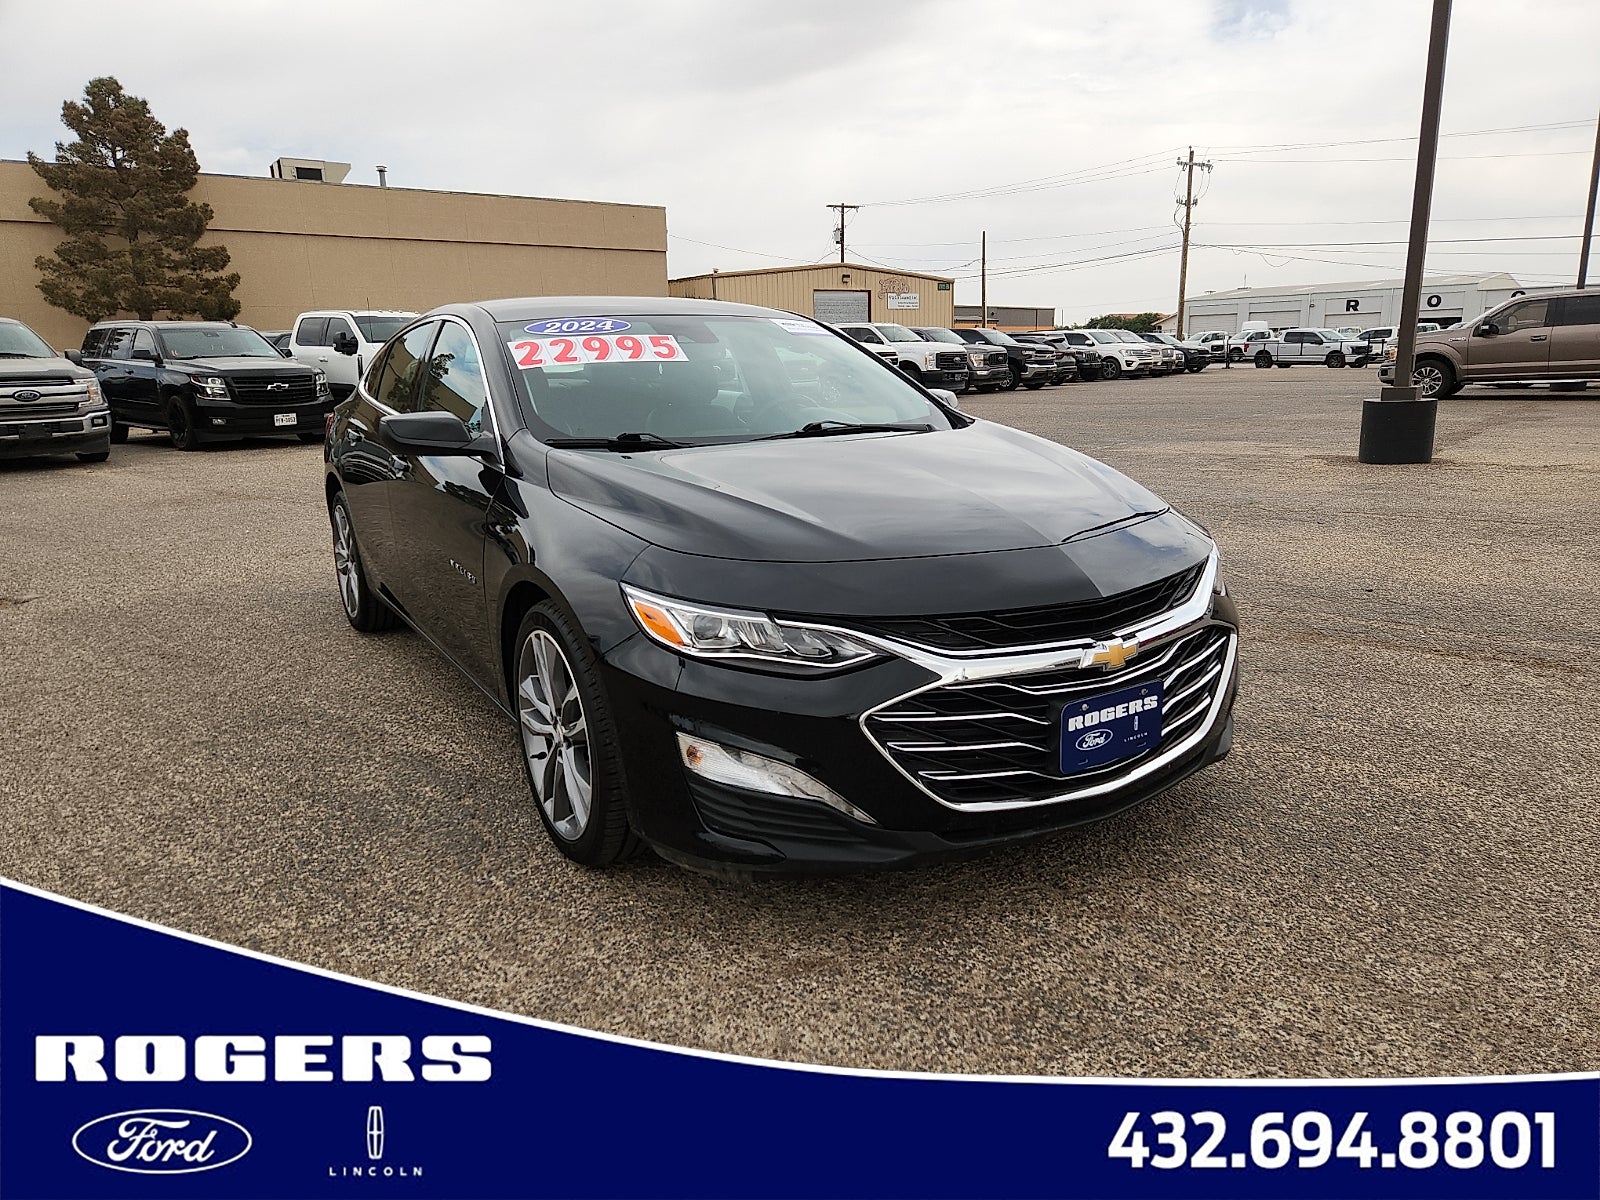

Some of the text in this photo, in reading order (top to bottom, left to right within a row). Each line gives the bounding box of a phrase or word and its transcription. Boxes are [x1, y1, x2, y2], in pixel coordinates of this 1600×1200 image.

[1345, 294, 1442, 312] R O
[545, 319, 615, 334] 2024
[514, 335, 683, 367] 22995
[1068, 695, 1159, 732] ROGERS
[1123, 731, 1148, 743] LINCOLN
